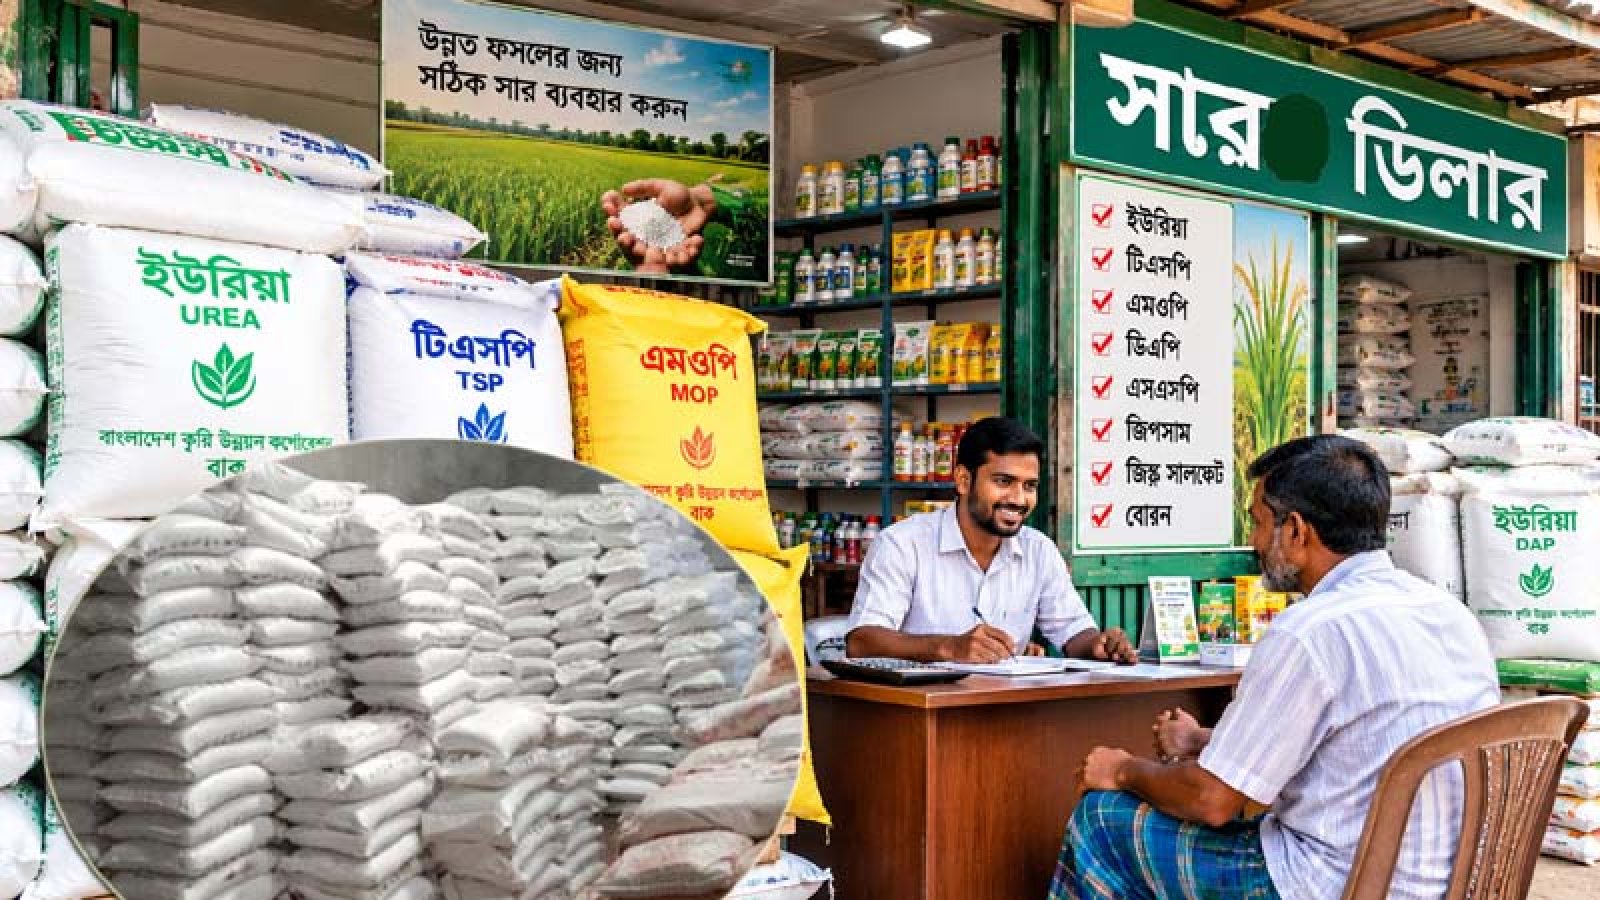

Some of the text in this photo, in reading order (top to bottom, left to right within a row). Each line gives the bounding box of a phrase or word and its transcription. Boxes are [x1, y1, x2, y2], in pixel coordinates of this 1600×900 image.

[417, 18, 624, 78] উন্নত ফসলের জন্য
[417, 59, 689, 122] সঠিক সার ব্যবহার করুন
[1345, 95, 1549, 232] ডিলার
[1125, 202, 1189, 241] ইউরিয়া
[136, 247, 292, 303] ইউরিয়া
[1125, 243, 1192, 281] টিএসপি
[181, 304, 261, 329] UREA
[1125, 291, 1190, 321] এমওপি
[410, 319, 537, 369] টিএসপি
[1124, 328, 1182, 360] ডিএপি
[639, 343, 738, 380] এমওপি
[455, 371, 503, 393] TSP
[671, 383, 719, 404] MOP
[1125, 374, 1201, 403] এসএসপি
[1124, 413, 1192, 443] জিপসাম
[1125, 503, 1173, 527] বোরন
[1492, 503, 1578, 534] ইউরিয়া
[1515, 537, 1556, 552] DAP
